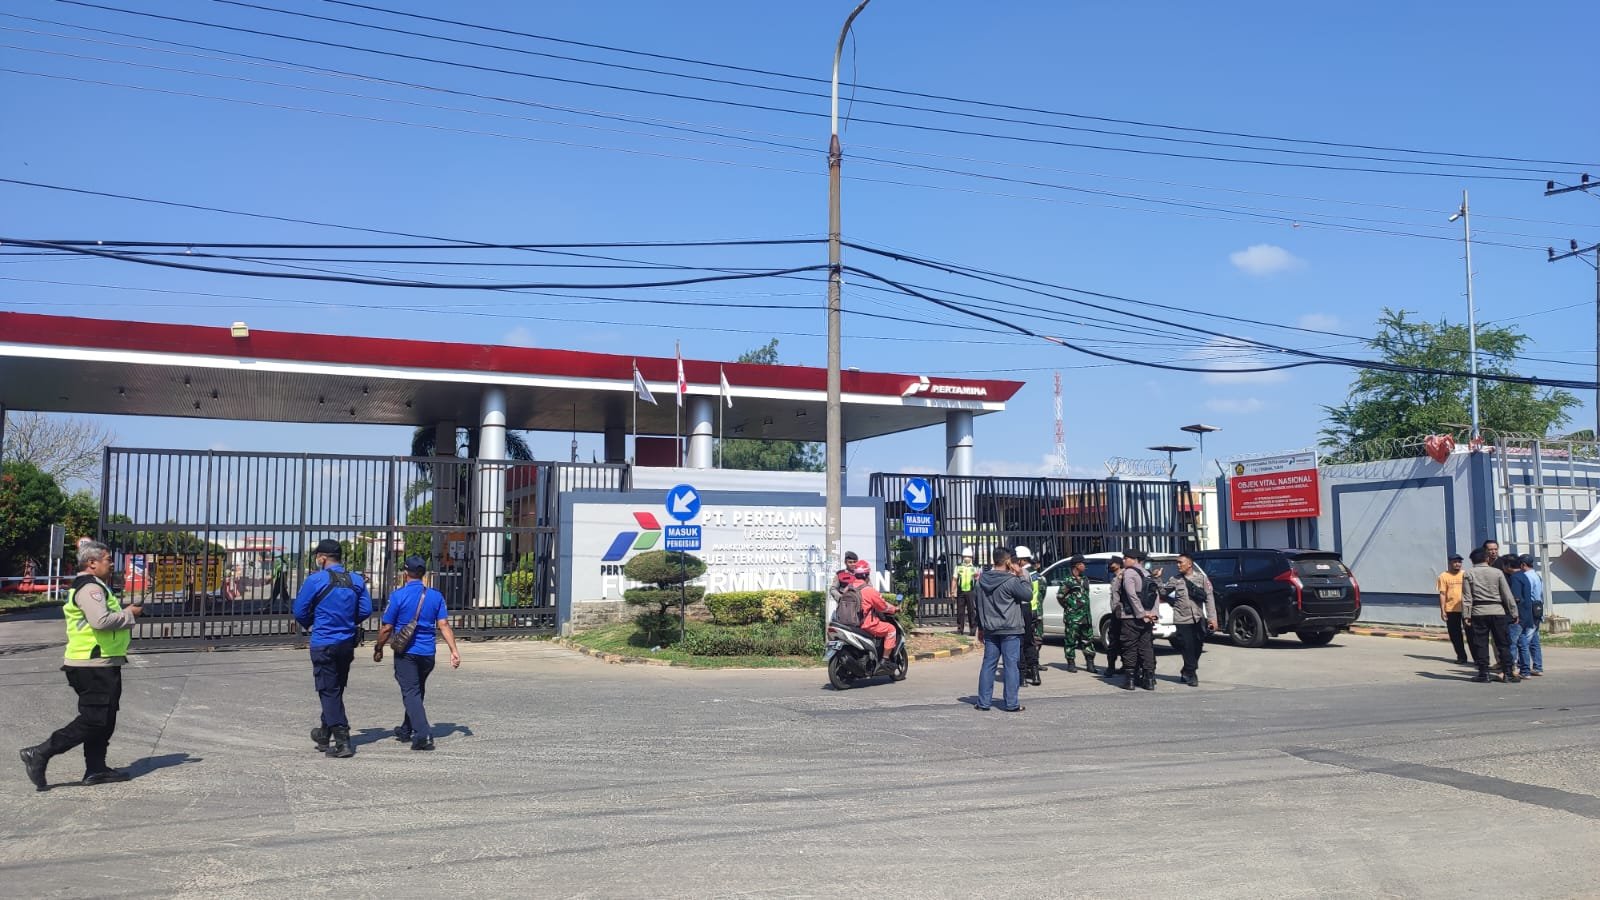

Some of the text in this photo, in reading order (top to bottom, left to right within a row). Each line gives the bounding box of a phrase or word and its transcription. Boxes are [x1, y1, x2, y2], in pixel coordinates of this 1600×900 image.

[931, 384, 987, 396] PERTAMINA
[1238, 481, 1259, 489] OBJEK
[1260, 479, 1277, 487] VITAL
[1279, 475, 1312, 485] NASIONAL
[701, 511, 727, 526] PT.
[733, 511, 826, 526] PERTAMIN
[906, 516, 931, 524] MASUK
[668, 528, 698, 537] MASUK
[732, 553, 796, 565] TERMINAL
